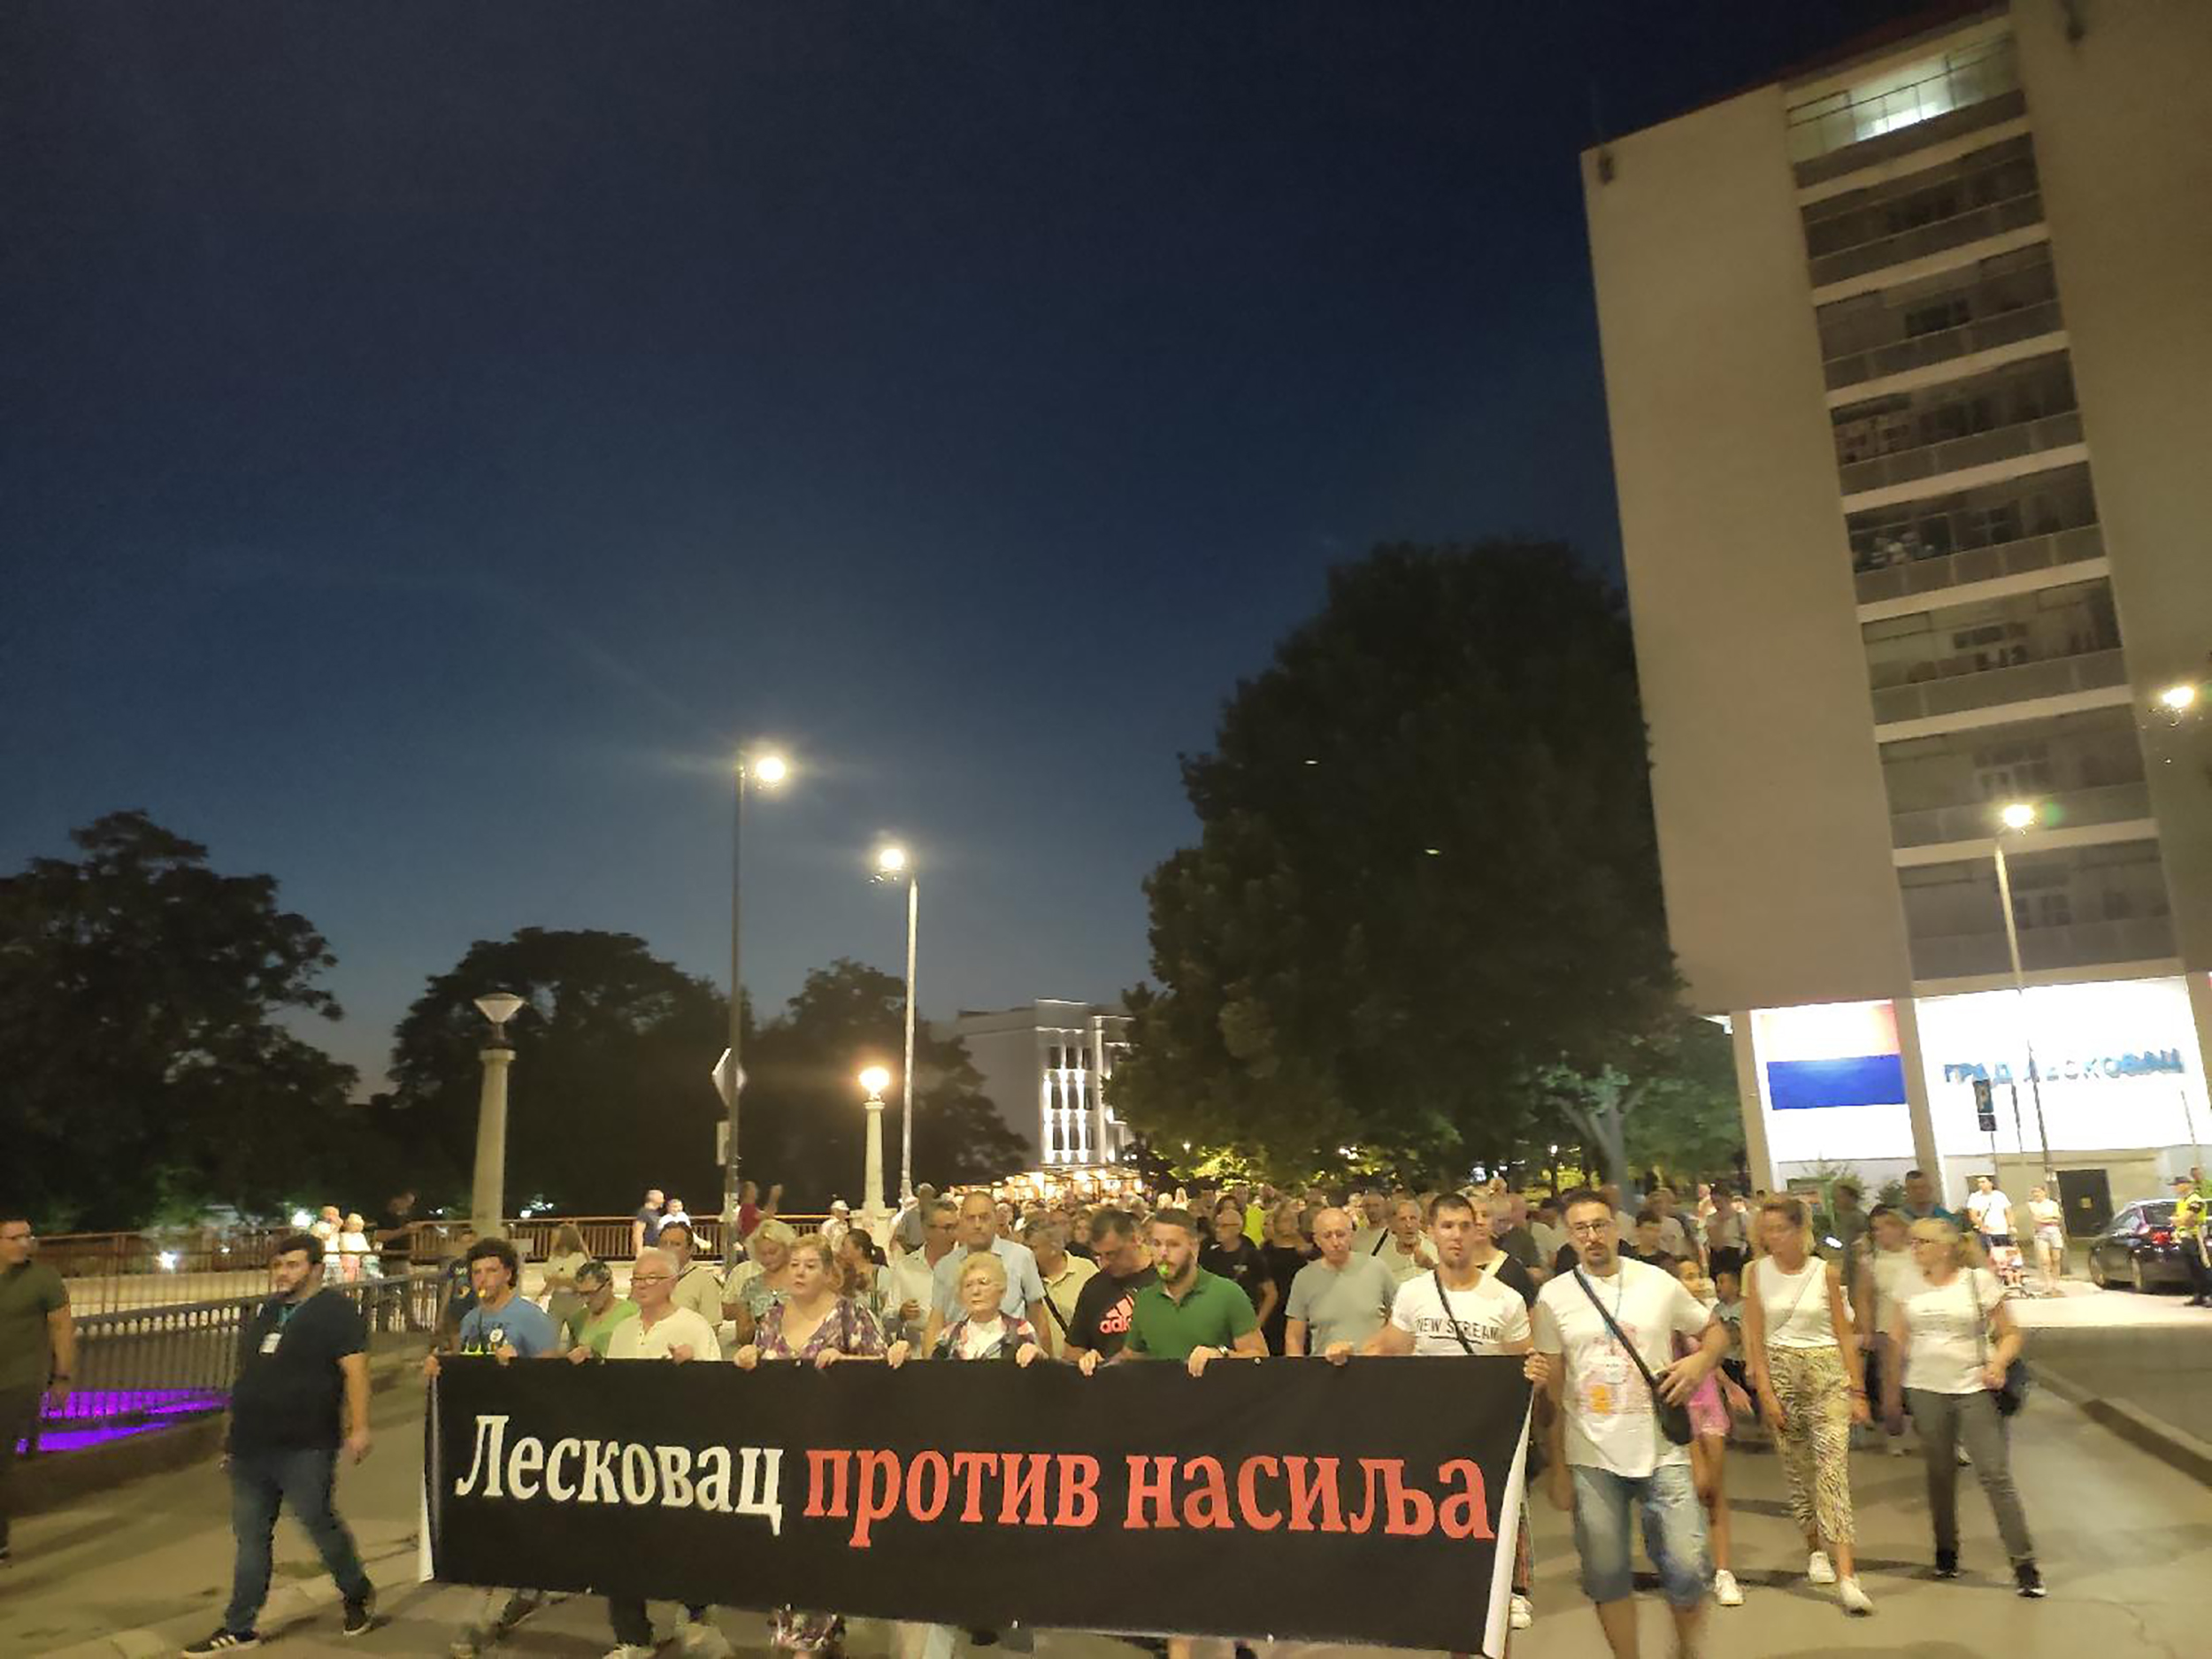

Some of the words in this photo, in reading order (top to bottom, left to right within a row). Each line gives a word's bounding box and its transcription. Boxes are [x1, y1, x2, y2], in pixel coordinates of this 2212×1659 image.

[1416, 1317, 1442, 1333] NEW
[456, 1416, 783, 1535] Лесковац
[803, 1449, 1100, 1548] против
[1124, 1455, 1495, 1539] насиља
